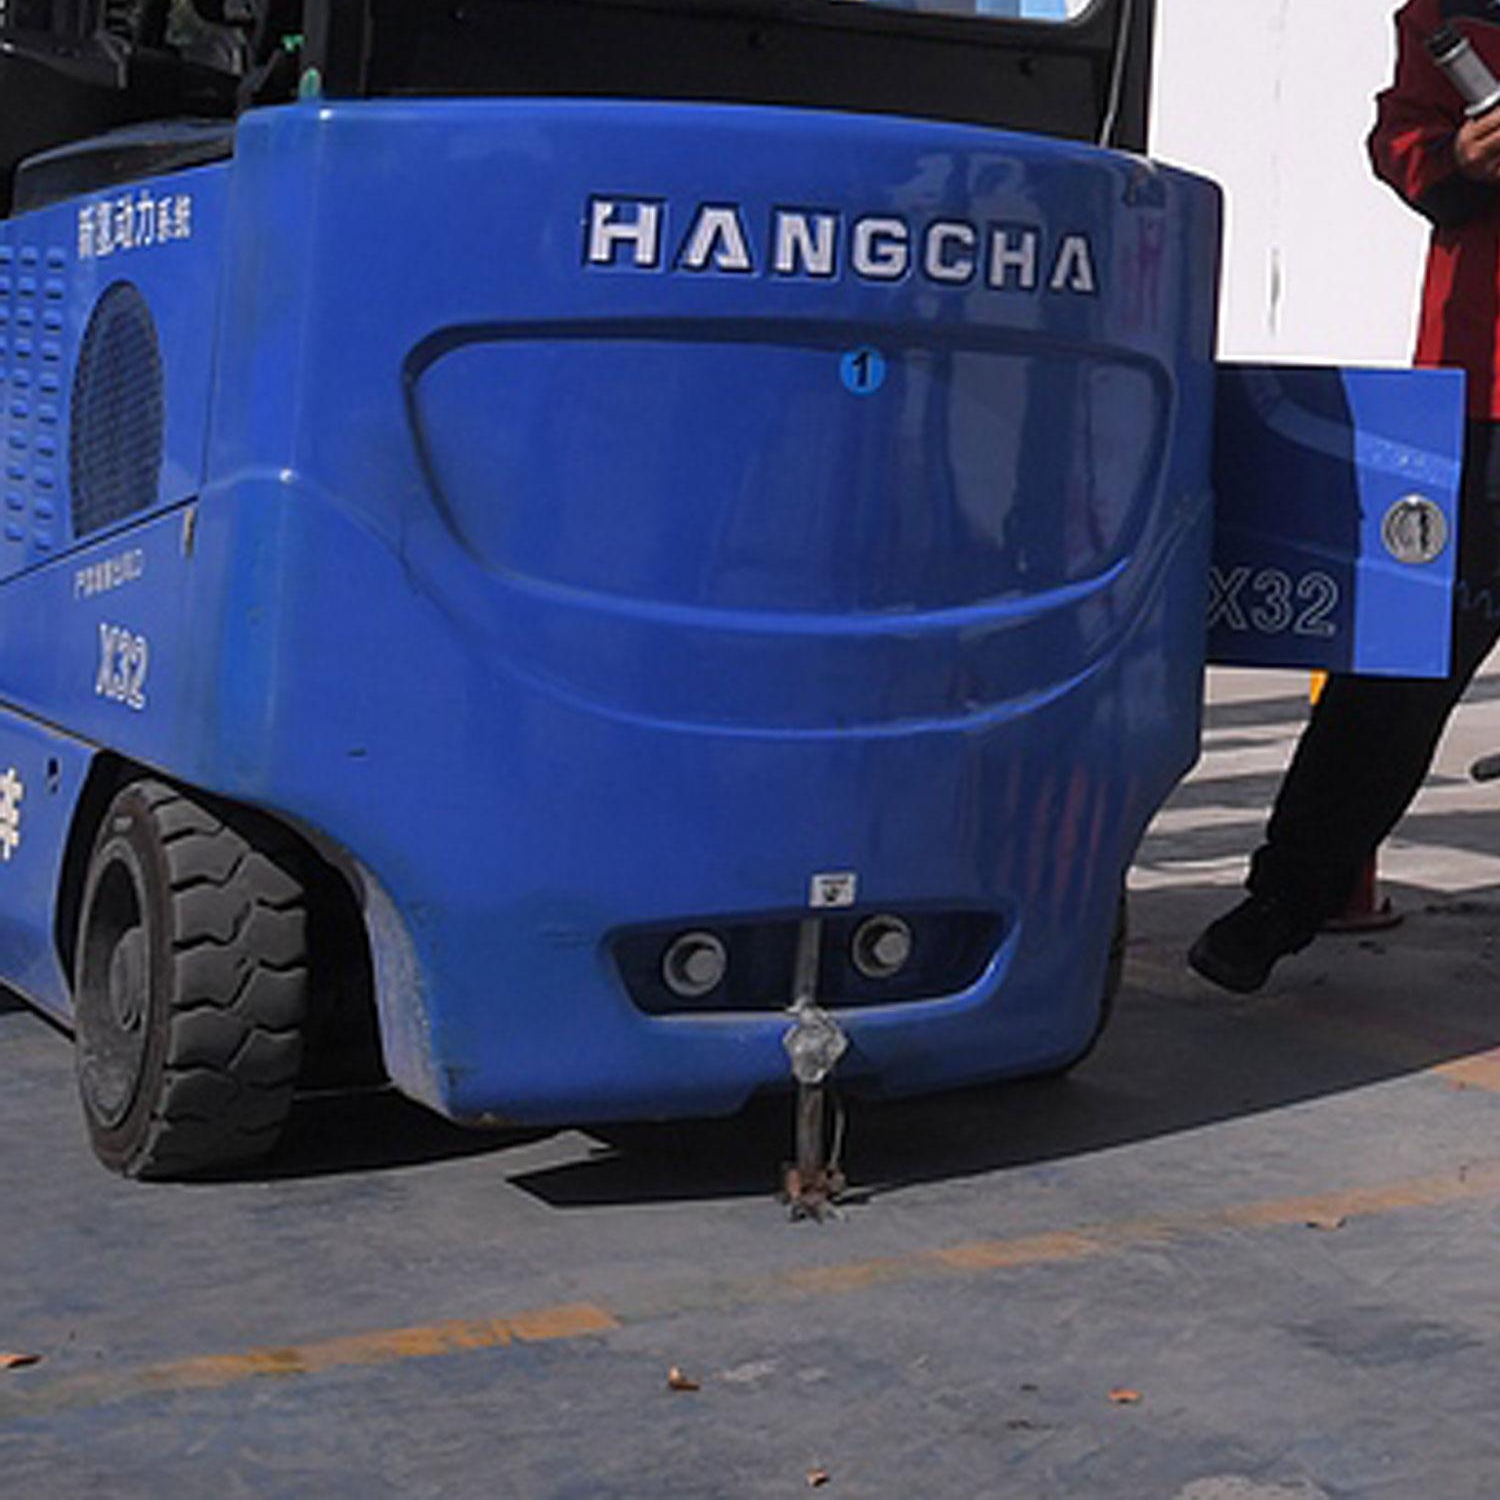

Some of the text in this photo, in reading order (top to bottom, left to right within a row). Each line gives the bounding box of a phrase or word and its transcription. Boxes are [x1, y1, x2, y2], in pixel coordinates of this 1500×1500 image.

[586, 200, 1096, 293] HANGCHA
[852, 350, 871, 388] 1
[1208, 565, 1339, 636] X32
